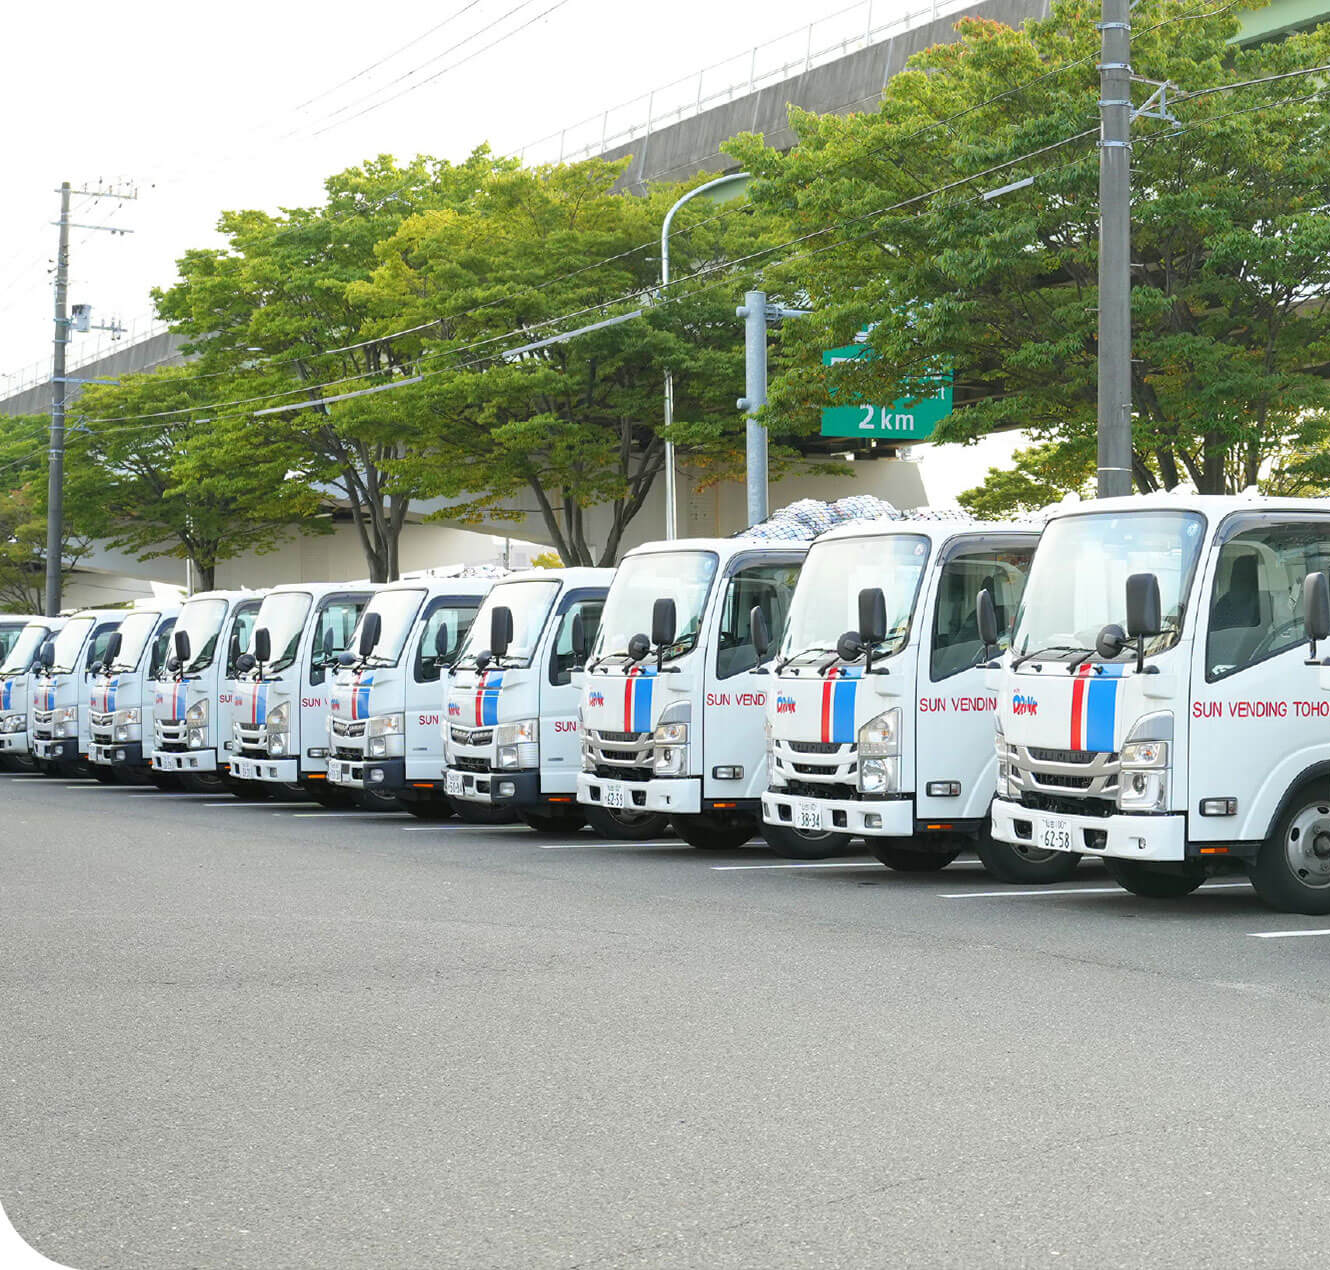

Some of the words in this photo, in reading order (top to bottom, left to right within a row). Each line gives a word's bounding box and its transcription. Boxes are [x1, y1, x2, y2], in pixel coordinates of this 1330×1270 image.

[859, 404, 875, 429] 2
[881, 406, 914, 430] km
[220, 695, 233, 704] SU
[302, 698, 321, 707] SUN
[706, 693, 731, 706] SUN
[736, 693, 767, 706] VEND
[919, 697, 946, 712] SUN
[952, 697, 997, 711] VENDIN
[1192, 701, 1222, 718] SUN
[1229, 701, 1287, 717] VENDING
[419, 715, 439, 725] SUN
[555, 721, 577, 732] SUN
[1045, 830, 1070, 848] 62-58
